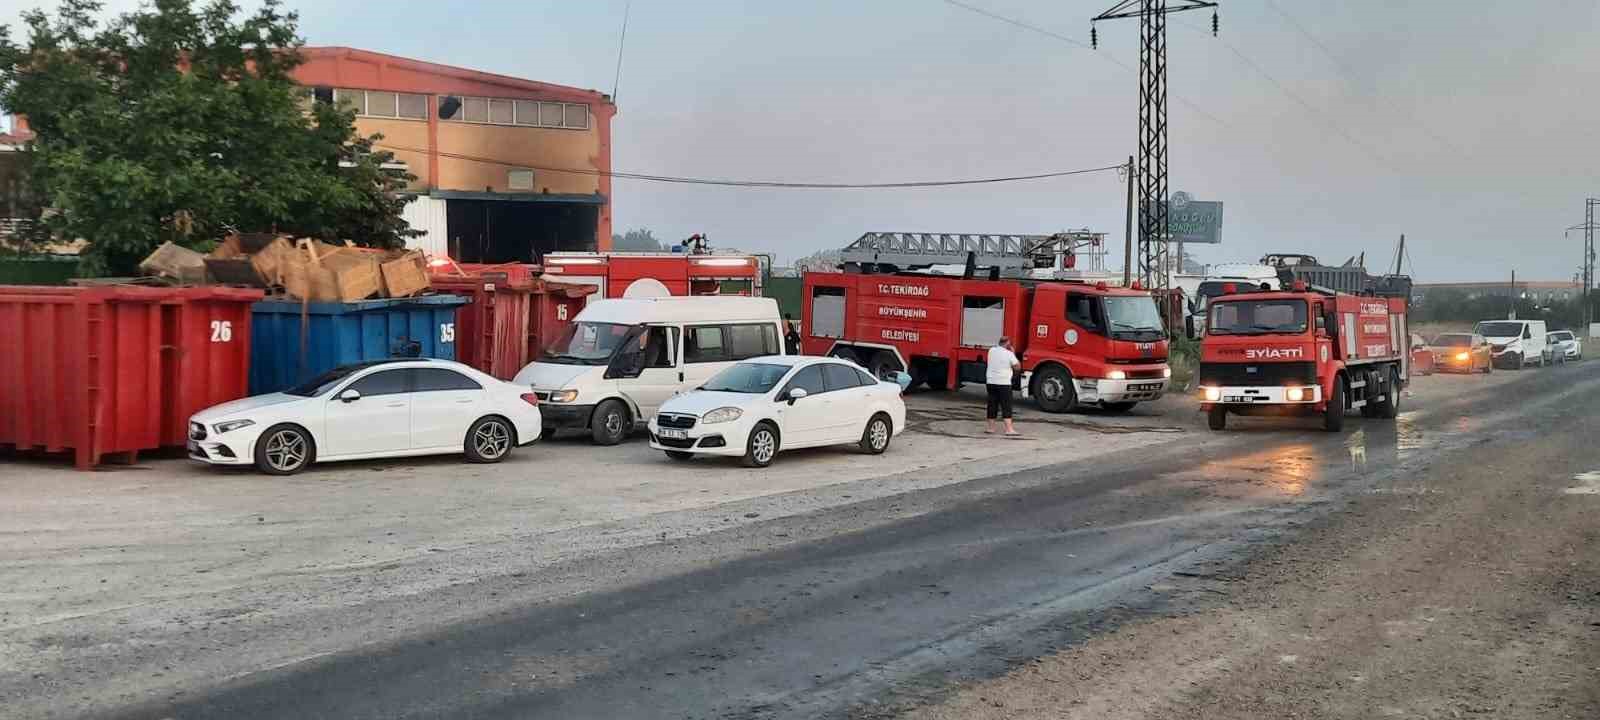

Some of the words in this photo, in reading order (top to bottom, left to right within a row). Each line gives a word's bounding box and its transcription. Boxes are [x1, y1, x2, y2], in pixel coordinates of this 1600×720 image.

[890, 284, 929, 297] TEKİRDAĞ
[557, 303, 567, 321] 15
[210, 320, 232, 342] 26
[440, 323, 455, 343] 35
